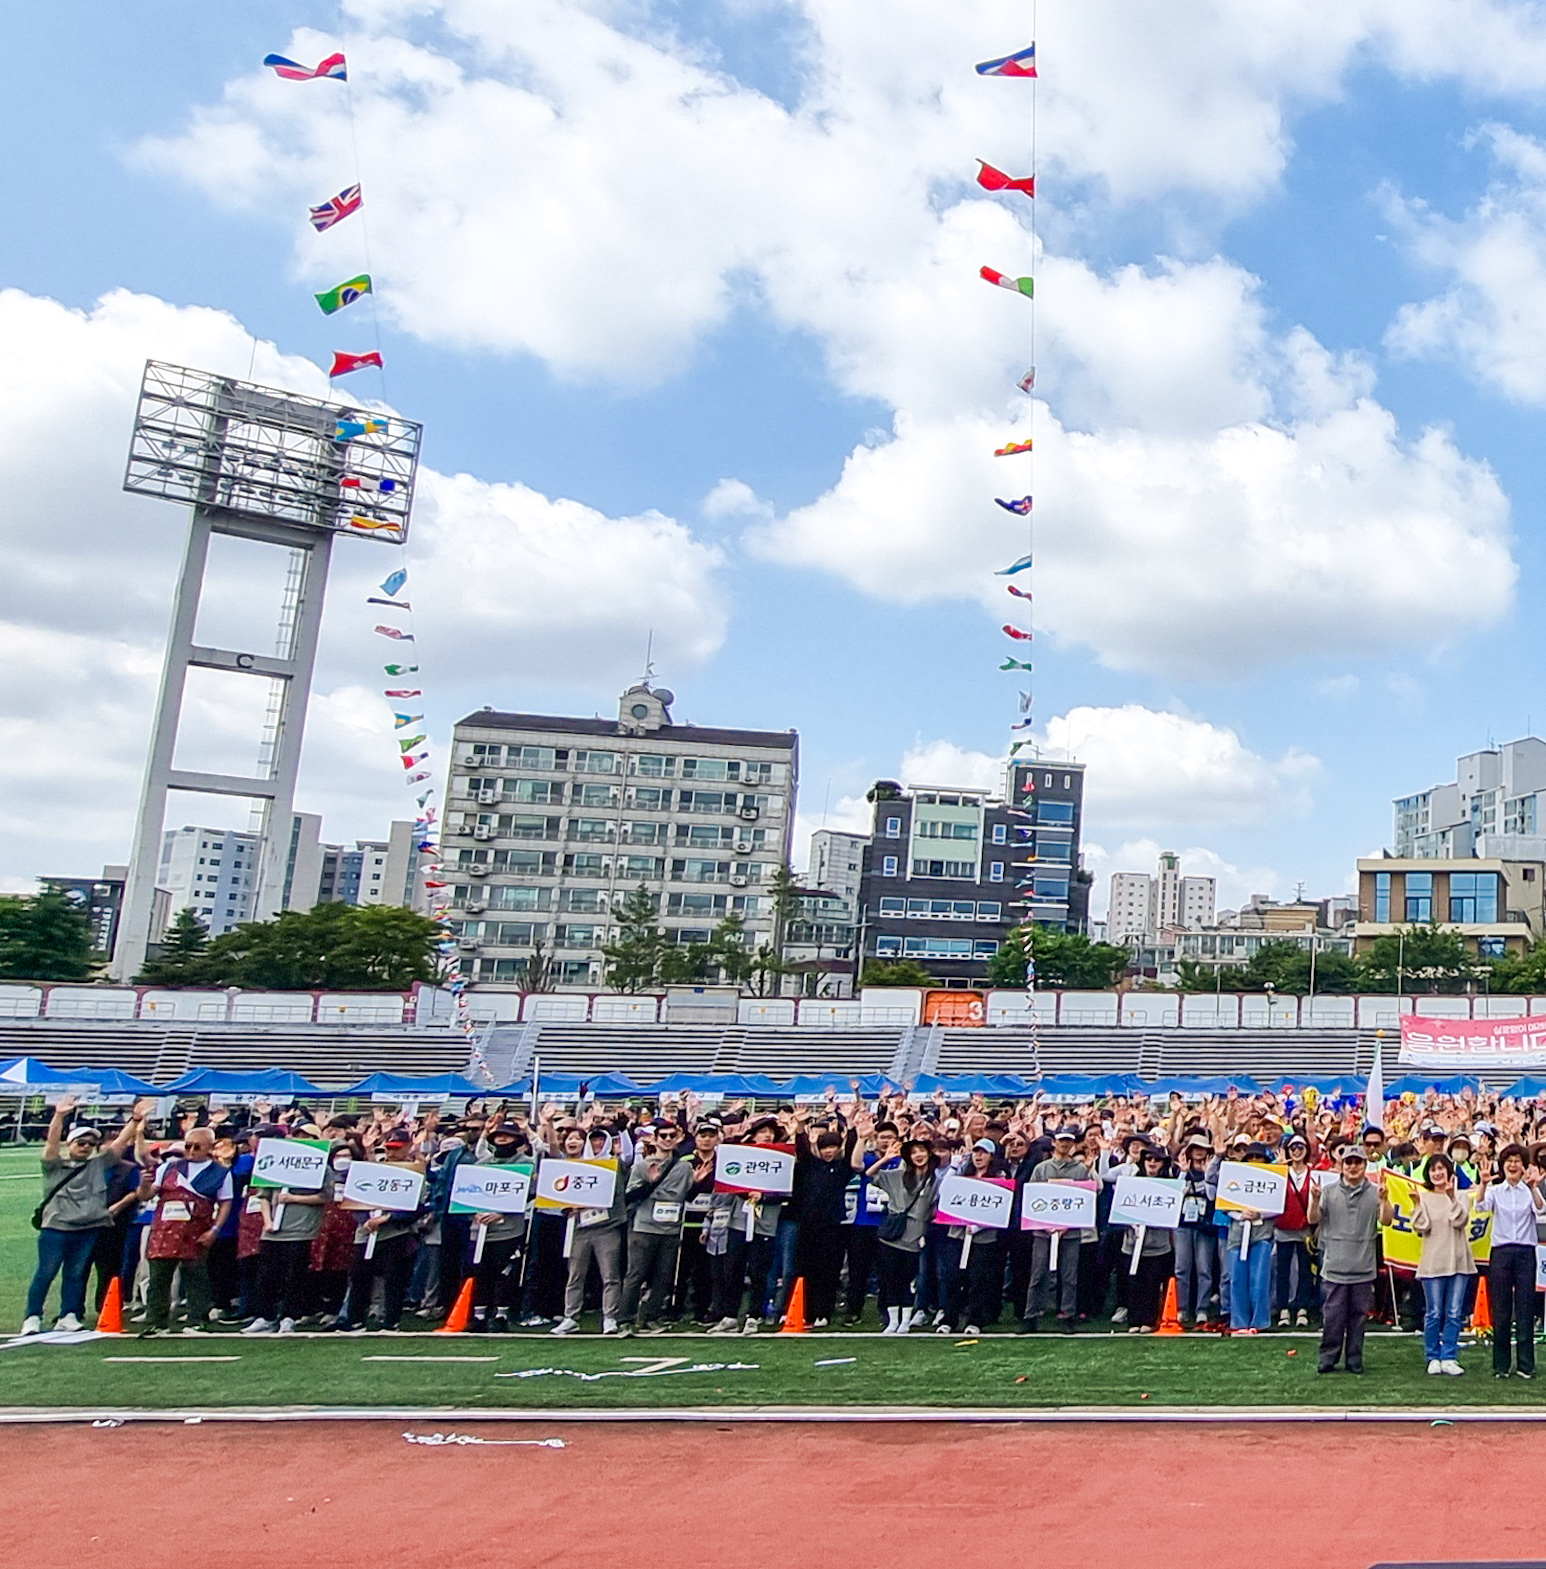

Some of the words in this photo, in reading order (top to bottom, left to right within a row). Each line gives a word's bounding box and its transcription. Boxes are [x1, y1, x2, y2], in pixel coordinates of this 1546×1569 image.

[236, 653, 255, 669] C
[968, 1001, 984, 1020] 3
[278, 1156, 324, 1171] 서대문구
[745, 1160, 783, 1174] 관악구
[377, 1178, 414, 1192] 강동구
[485, 1181, 525, 1194] 마포구
[572, 1176, 598, 1190] 중구
[1244, 1180, 1277, 1194] 금천구
[968, 1193, 1003, 1209] 용산구
[1049, 1197, 1085, 1211] 중랑구
[1139, 1194, 1176, 1209] 서초구
